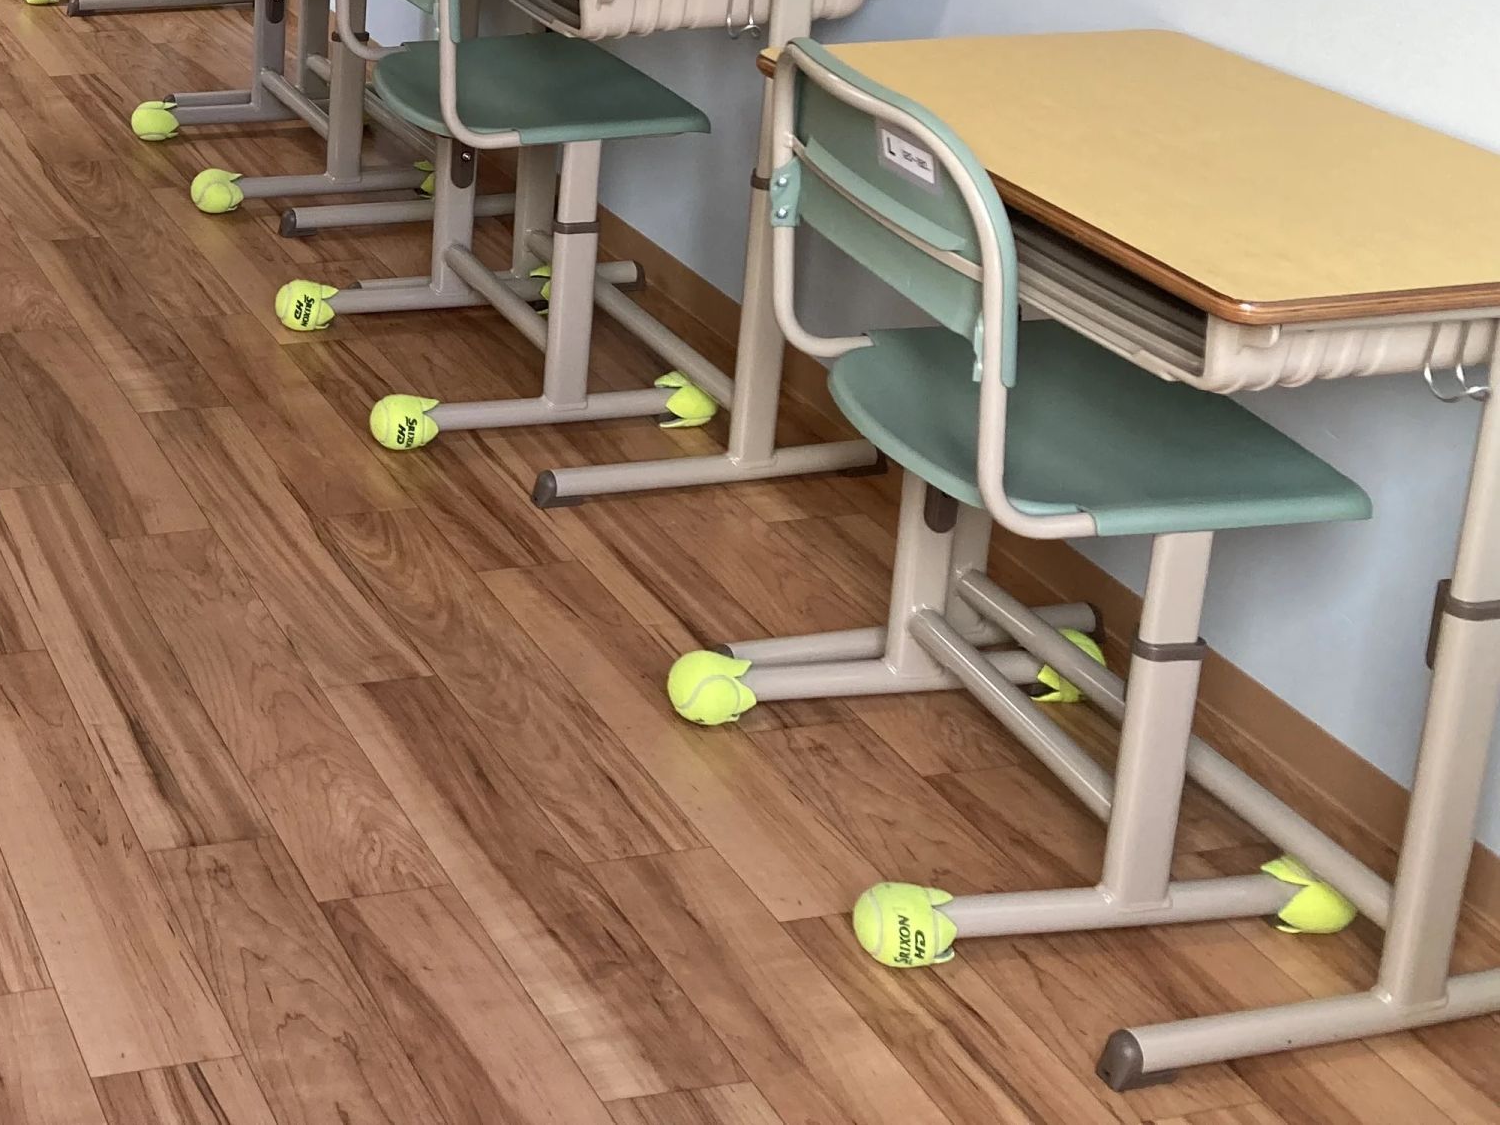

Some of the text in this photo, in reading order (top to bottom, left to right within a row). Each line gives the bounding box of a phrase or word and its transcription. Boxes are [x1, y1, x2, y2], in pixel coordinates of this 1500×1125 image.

[887, 137, 896, 156] L
[294, 300, 303, 320] HD
[301, 294, 315, 327] SRIXON
[397, 424, 406, 445] HD
[894, 915, 912, 965] SRIXON
[914, 930, 926, 959] HD
